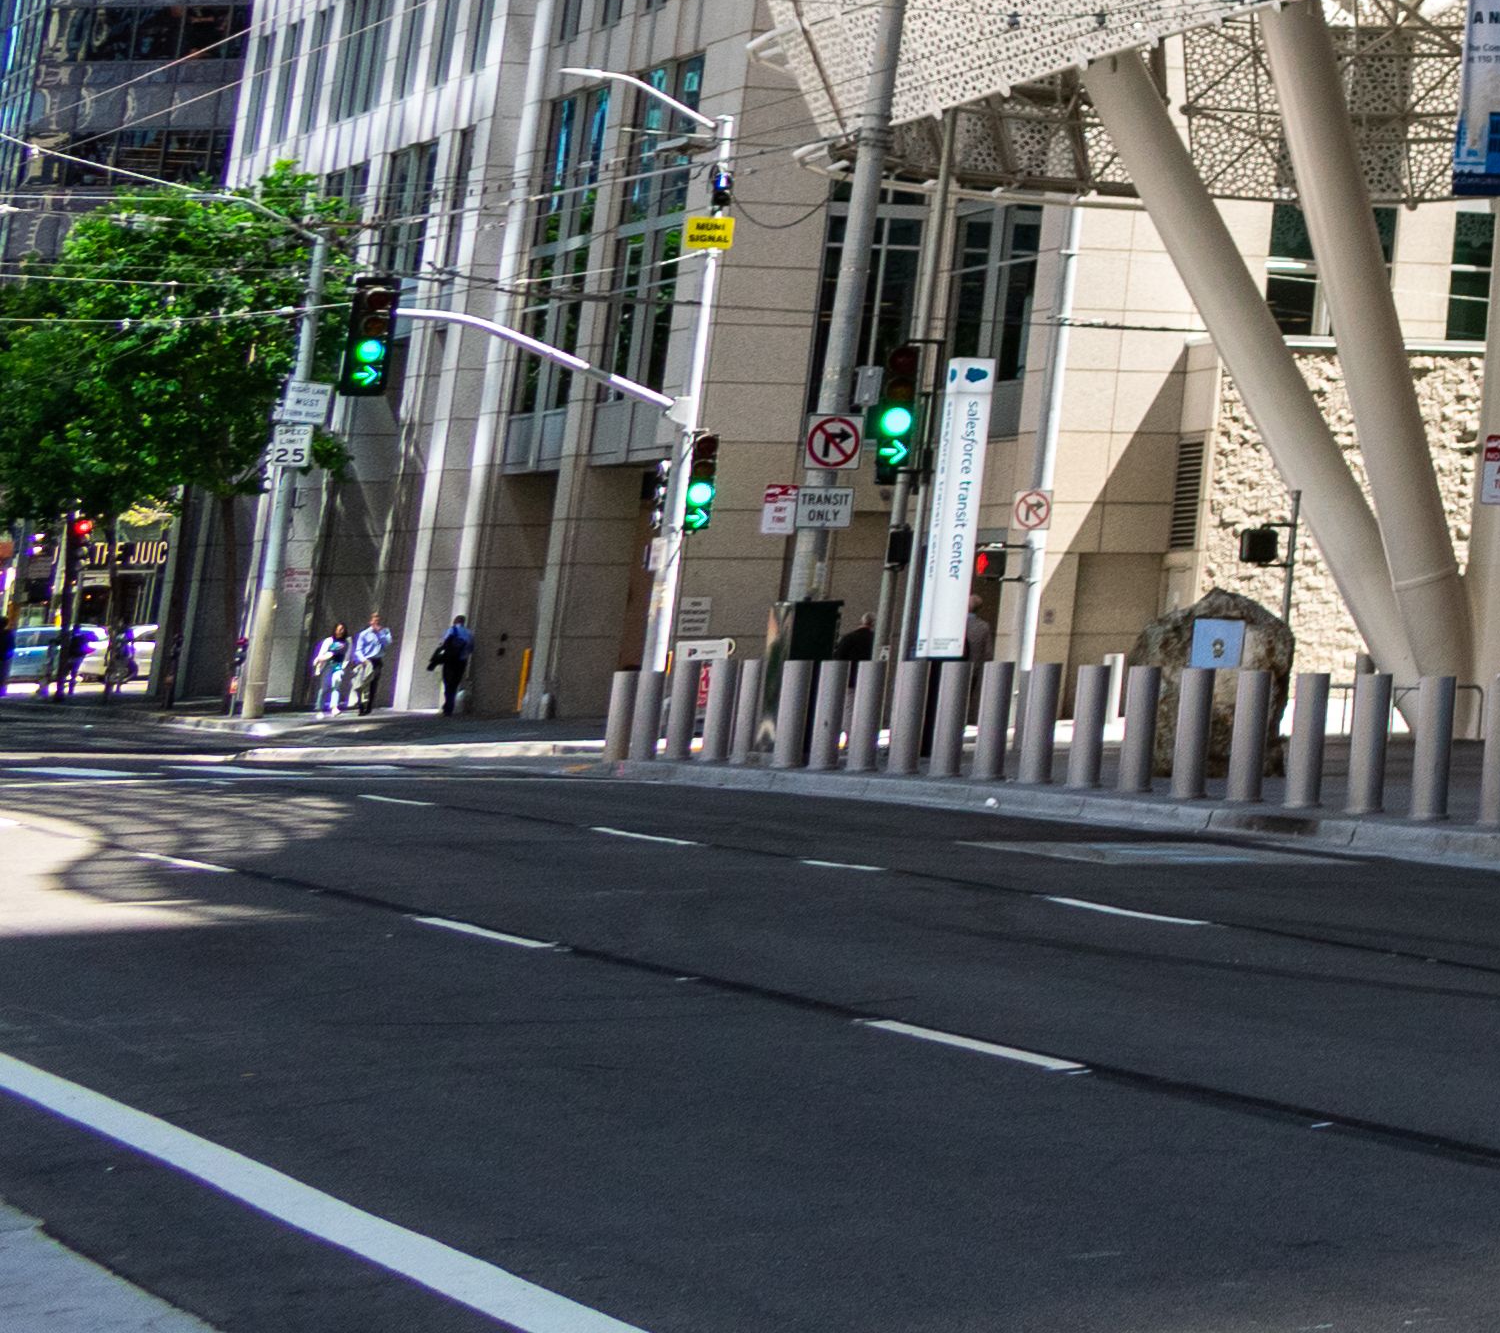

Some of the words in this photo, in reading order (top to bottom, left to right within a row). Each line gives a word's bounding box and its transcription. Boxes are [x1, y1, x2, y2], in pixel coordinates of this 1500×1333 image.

[1473, 11, 1484, 24] A
[696, 223, 725, 231] MUNI
[688, 235, 729, 243] SIGNAL
[960, 400, 981, 474] salesforce
[275, 447, 305, 463] 25
[801, 493, 849, 506] TRANSIT
[954, 481, 972, 529] transit
[808, 509, 840, 522] ONLY
[948, 534, 964, 580] center
